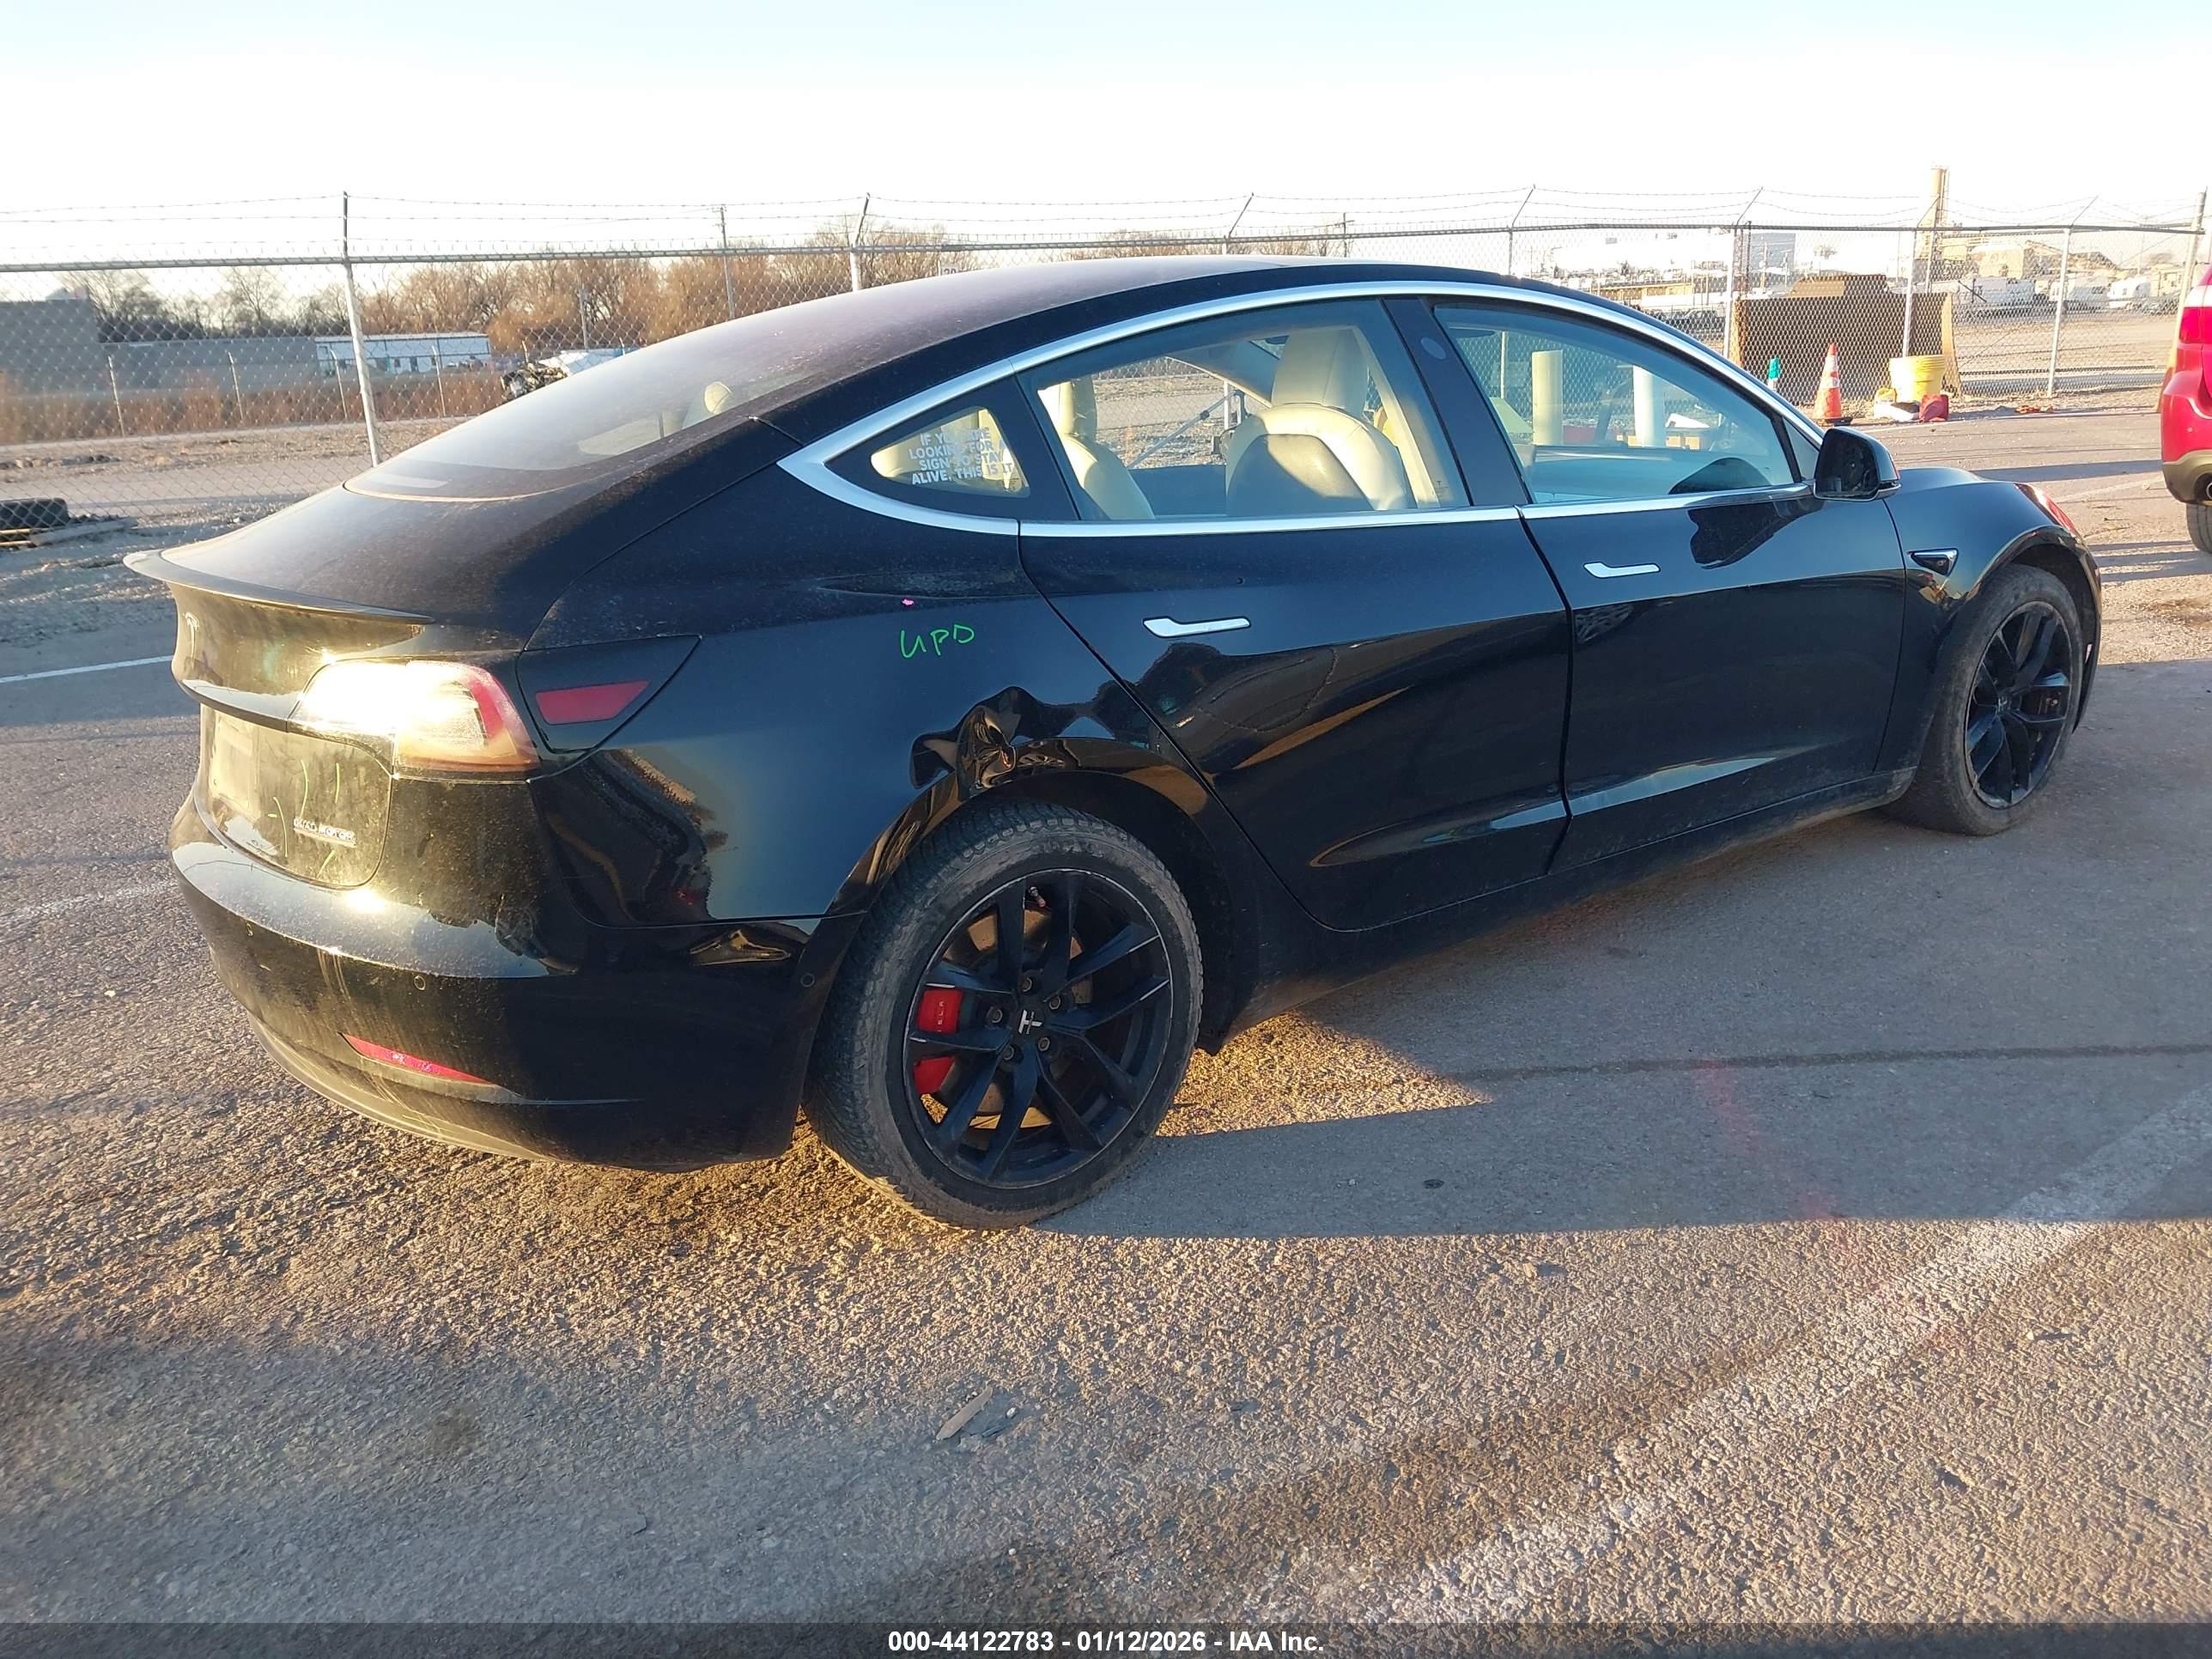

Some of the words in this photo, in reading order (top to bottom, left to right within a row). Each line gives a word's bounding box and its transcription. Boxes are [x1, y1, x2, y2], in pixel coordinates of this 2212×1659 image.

[920, 433, 932, 447] IF
[969, 439, 994, 453] FOR
[919, 457, 951, 471] SIGN
[955, 465, 982, 479] THIS
[986, 463, 999, 476] IS
[1002, 463, 1012, 473] IT
